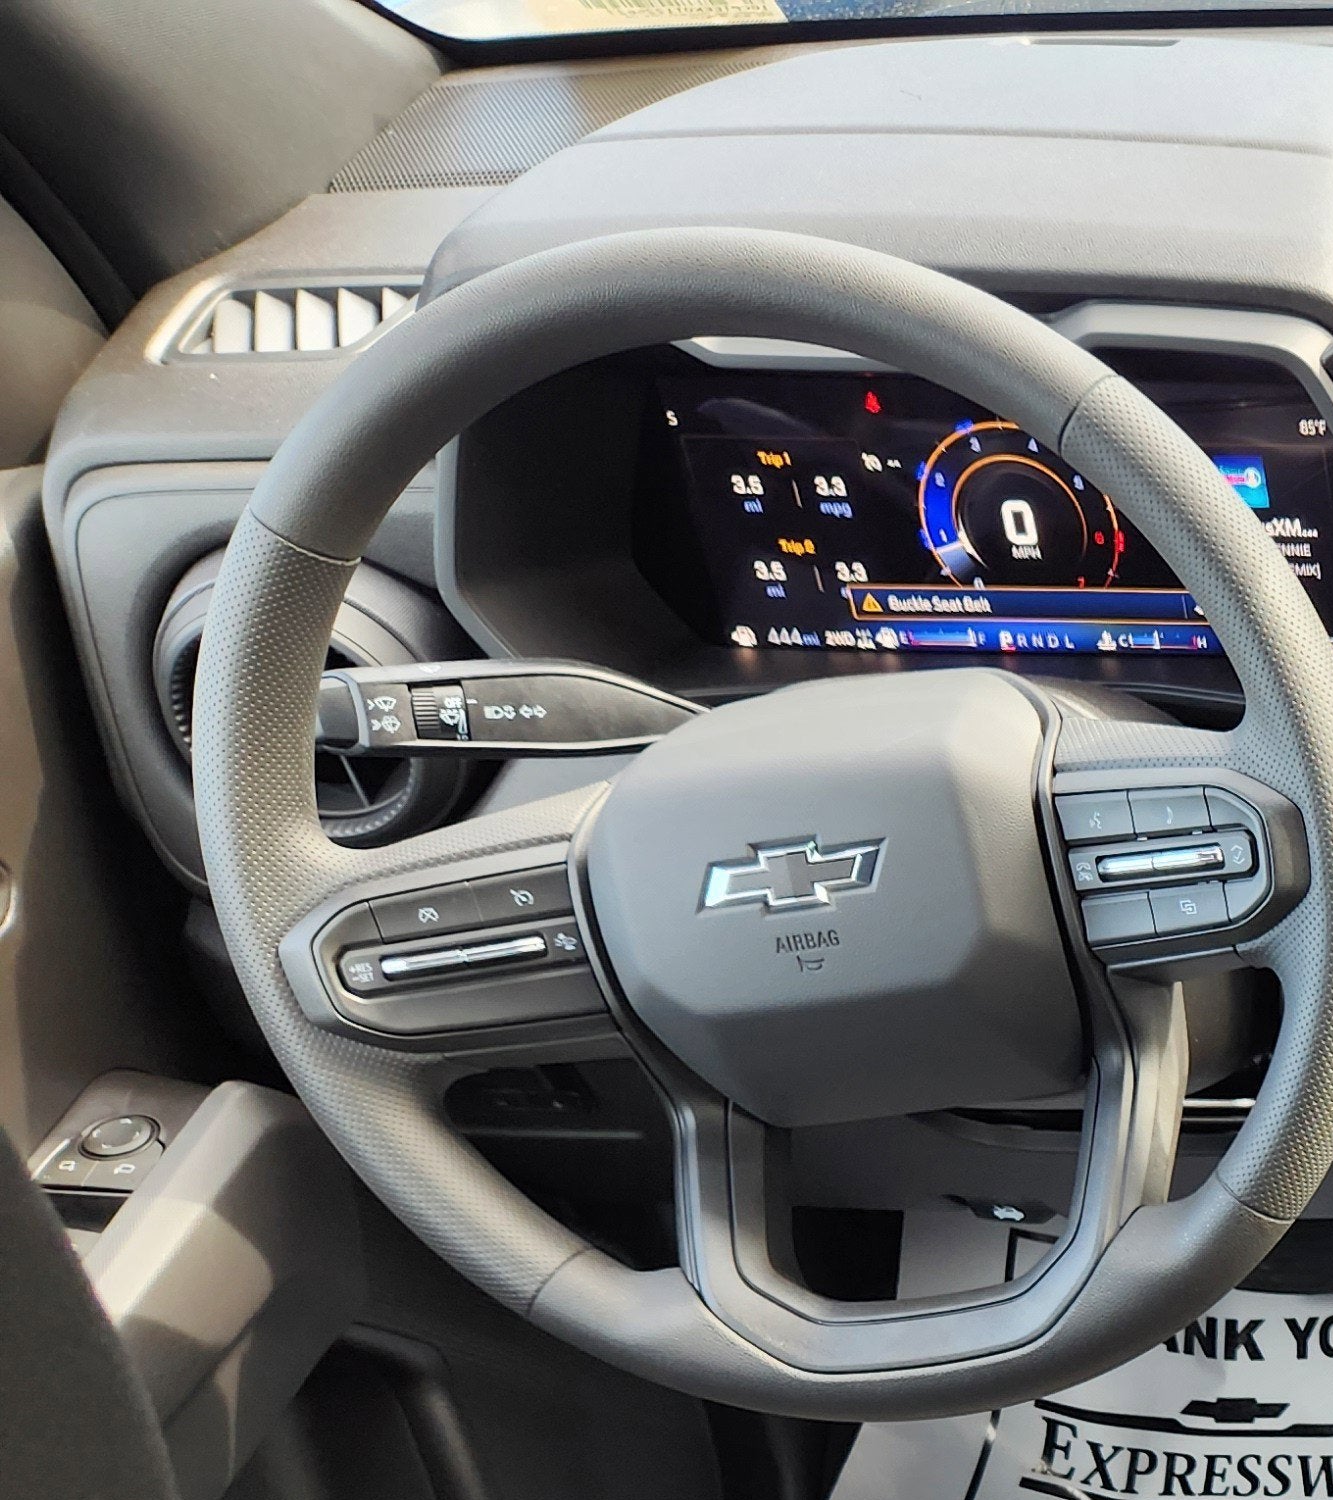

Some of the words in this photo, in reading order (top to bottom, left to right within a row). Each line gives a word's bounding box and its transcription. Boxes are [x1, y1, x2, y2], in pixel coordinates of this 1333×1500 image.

[756, 450, 783, 469] Trip
[820, 501, 853, 519] mpg
[1000, 499, 1039, 546] 0
[1011, 544, 1042, 560] MPH
[888, 594, 933, 613] Buckle
[932, 595, 964, 613] Seat
[962, 595, 993, 614] Belt
[775, 929, 841, 954] AIRBAG
